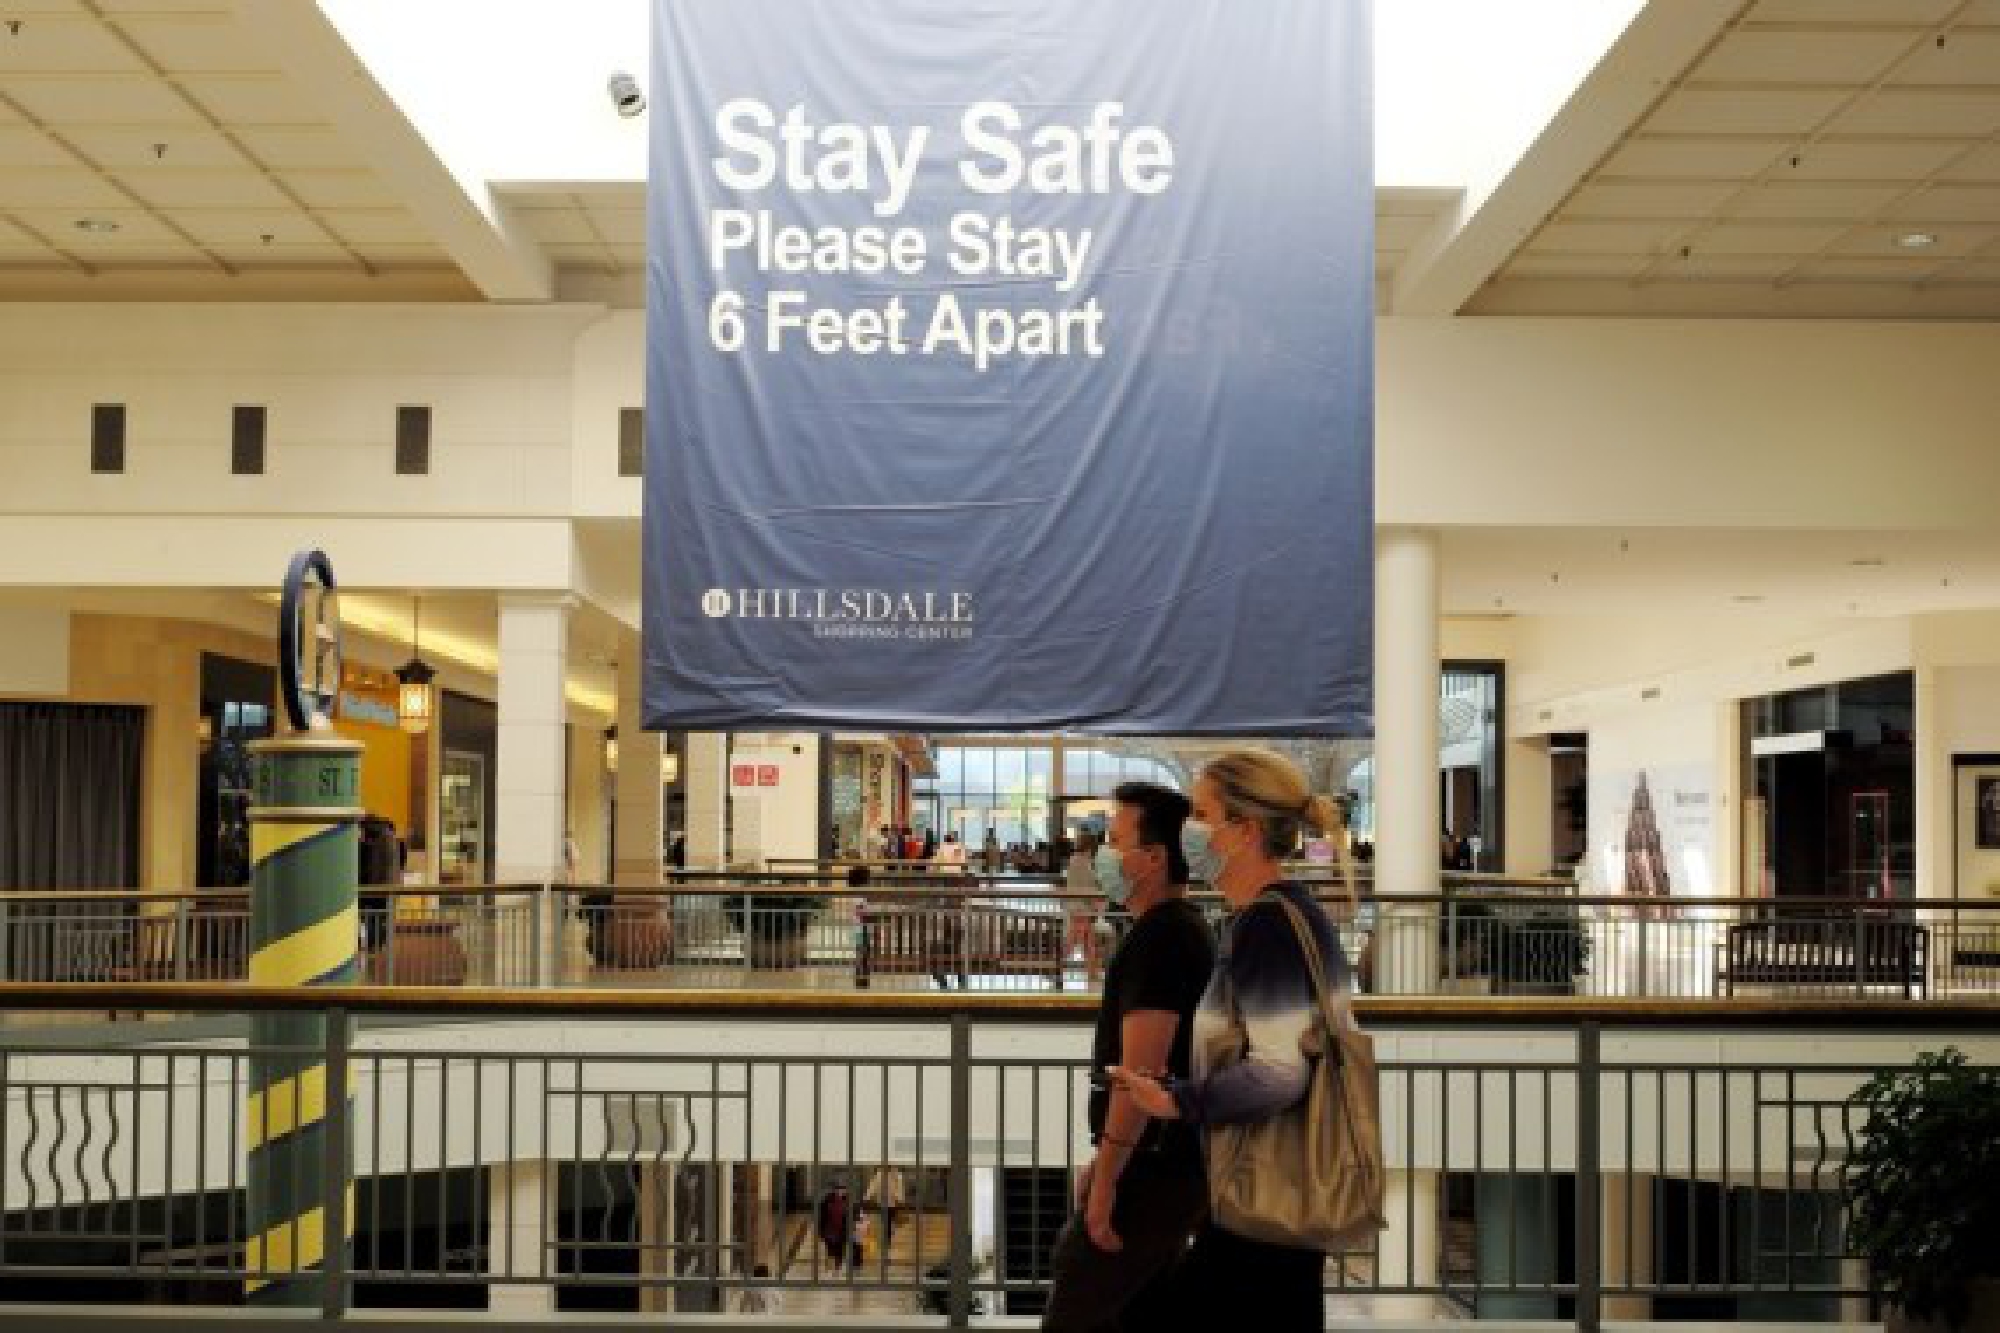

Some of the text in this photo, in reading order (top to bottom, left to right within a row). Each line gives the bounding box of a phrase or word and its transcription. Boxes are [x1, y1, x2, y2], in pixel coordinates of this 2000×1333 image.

[711, 97, 1174, 217] Stay Safe
[710, 208, 1092, 293] Please Stay
[708, 289, 746, 353] 6
[766, 289, 907, 356] Feet
[921, 292, 1105, 373] Apart
[736, 588, 974, 622] HILLSDALE
